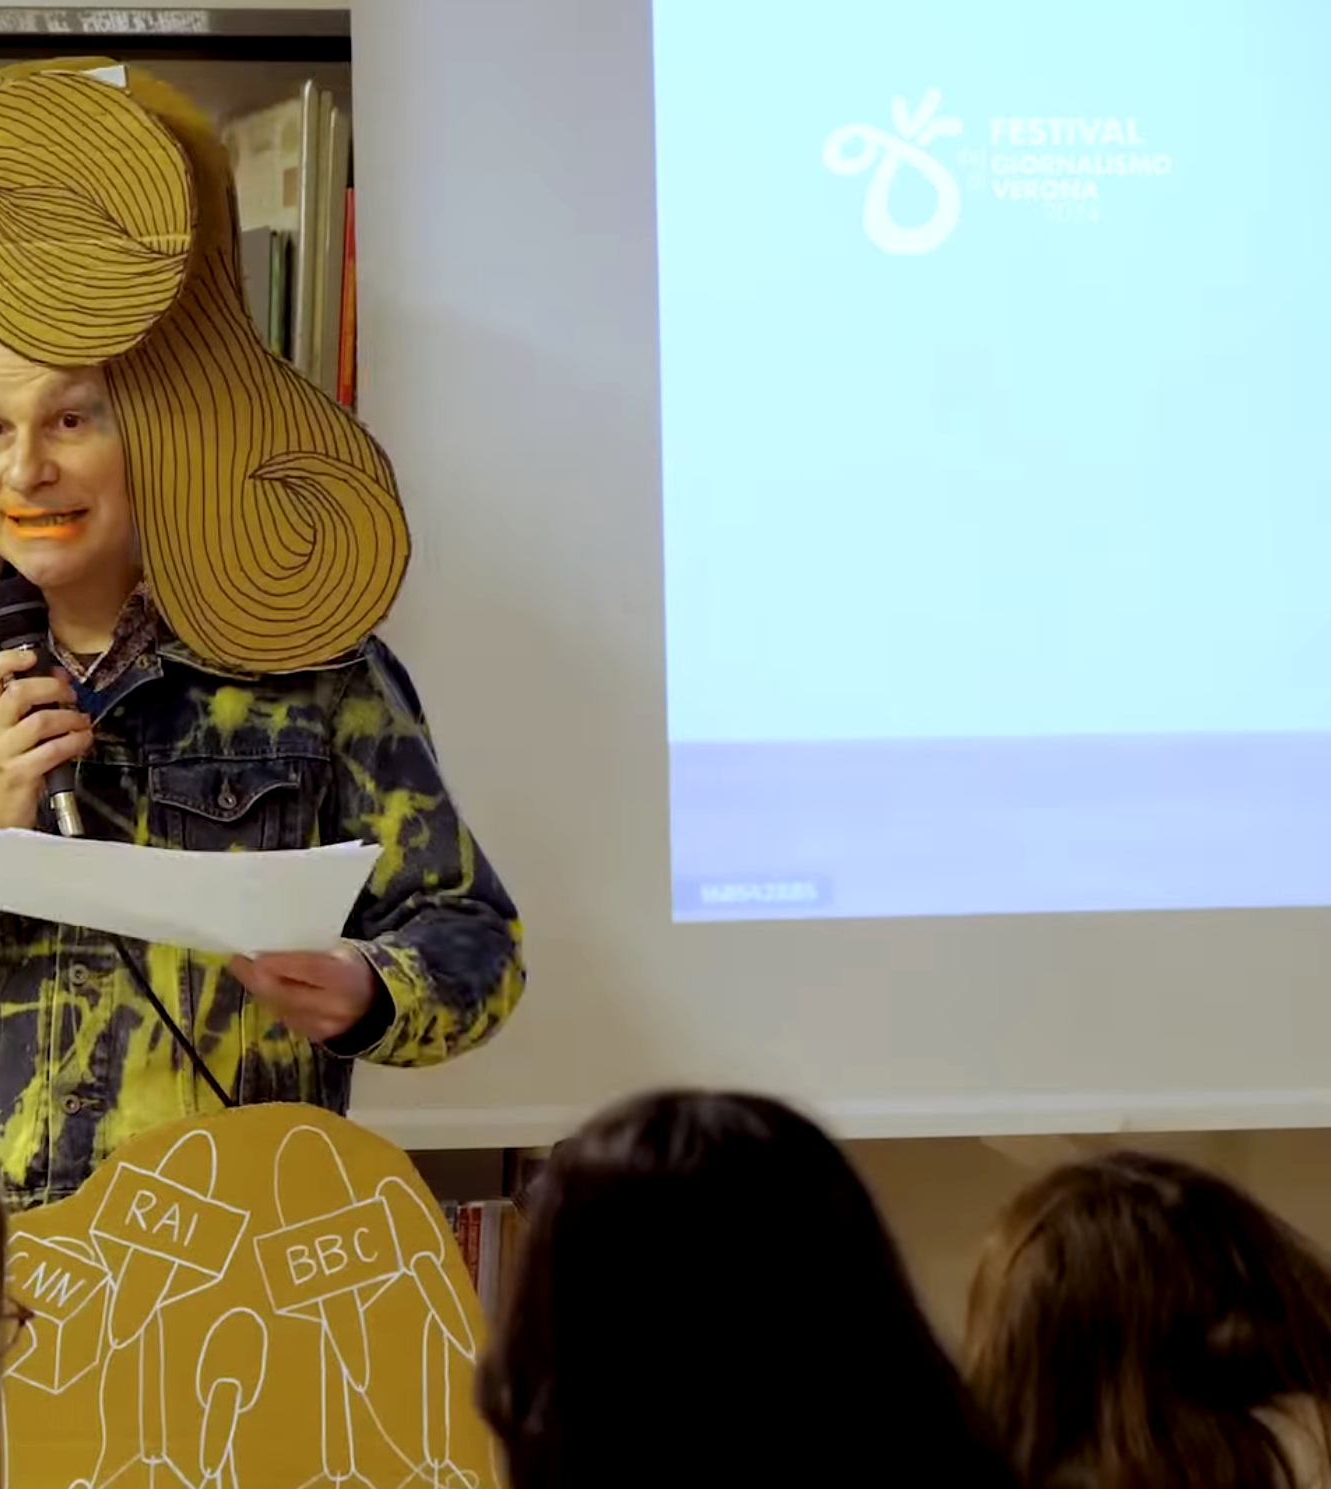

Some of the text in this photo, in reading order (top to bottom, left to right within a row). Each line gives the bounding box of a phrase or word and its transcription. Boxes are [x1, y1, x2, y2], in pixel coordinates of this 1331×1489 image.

[990, 117, 1144, 145] FESTIVAL
[991, 152, 1171, 176] GIORNALISMO
[992, 179, 1098, 201] VERONA
[125, 1190, 198, 1247] RAI
[286, 1228, 379, 1286] BBC
[8, 1252, 86, 1308] CNN
